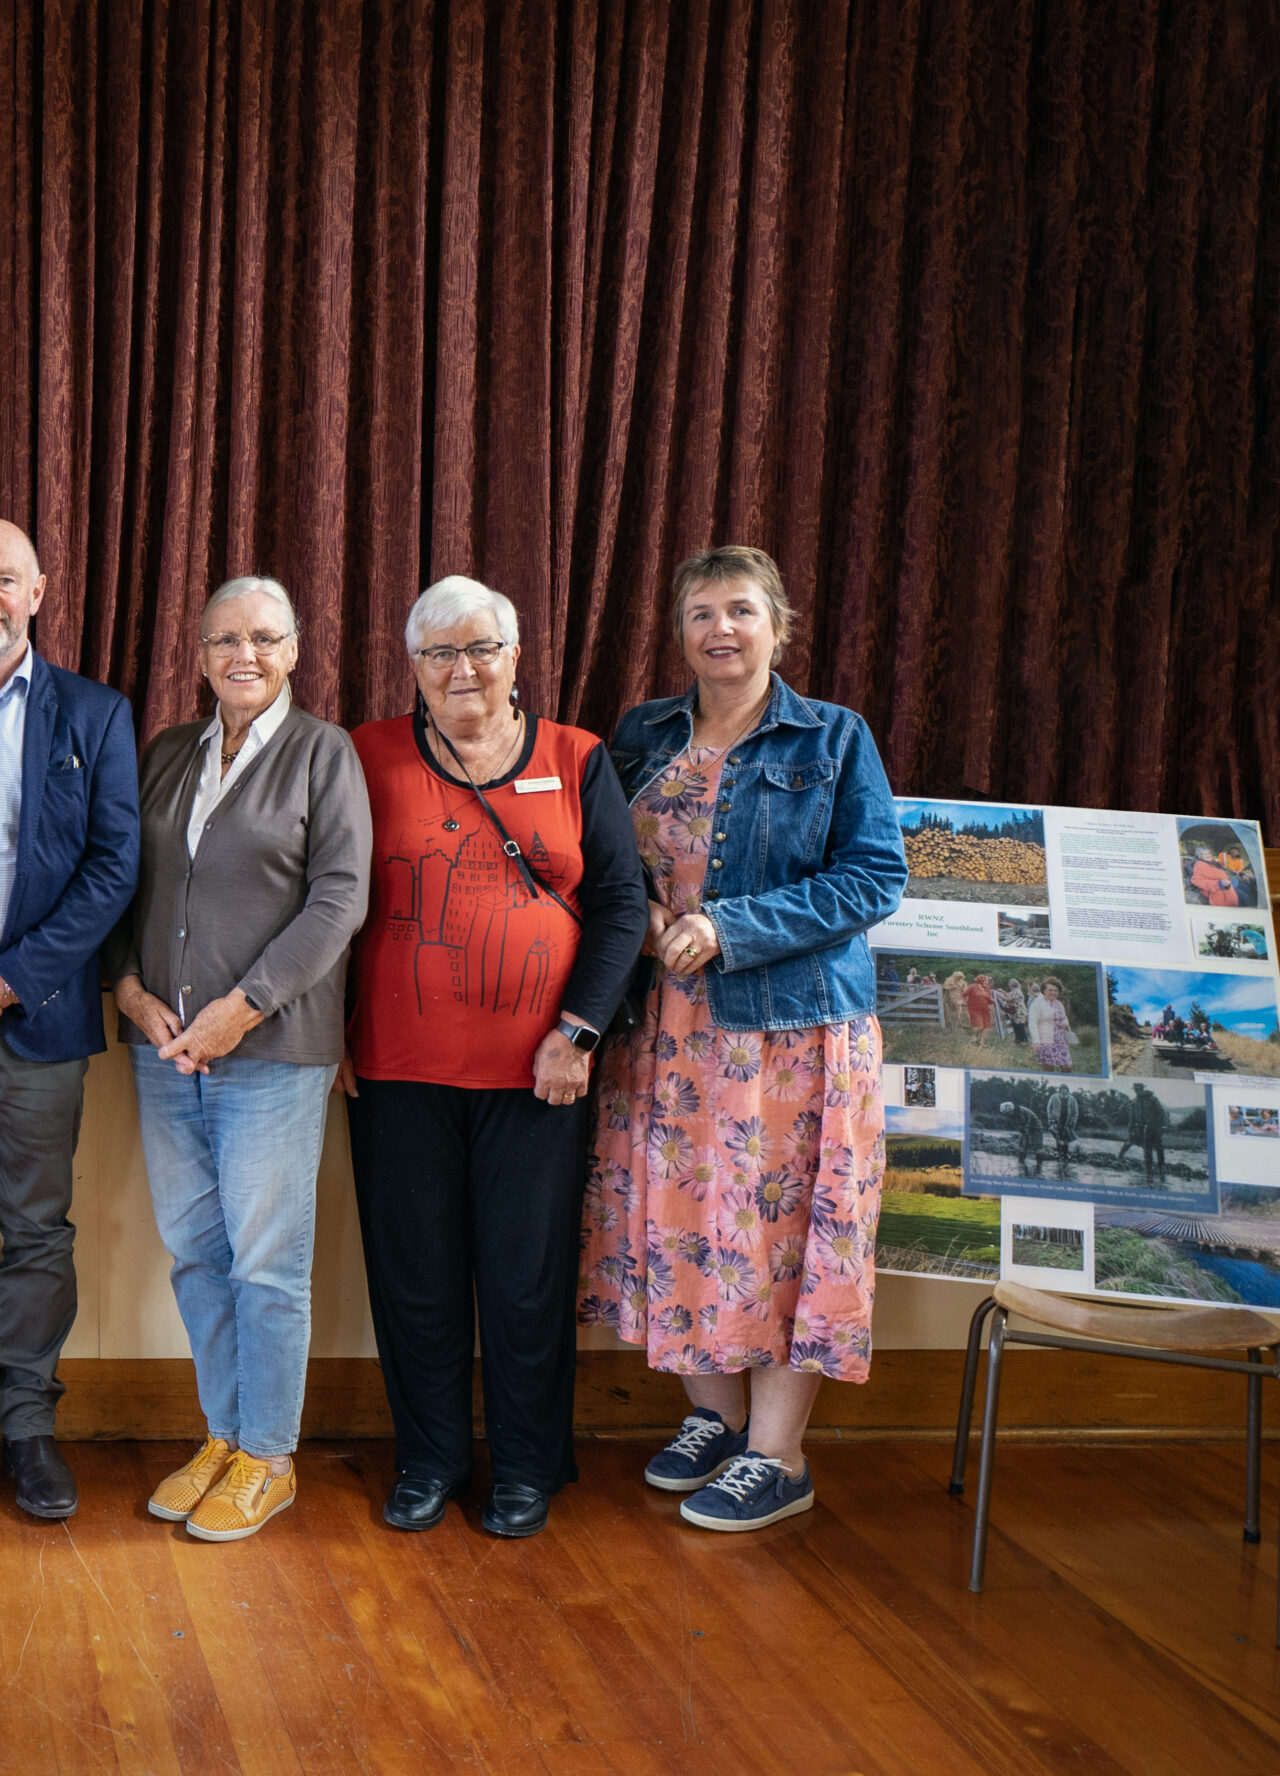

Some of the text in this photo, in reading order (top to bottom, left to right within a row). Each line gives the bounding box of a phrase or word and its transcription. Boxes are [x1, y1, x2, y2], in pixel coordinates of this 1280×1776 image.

[882, 919, 983, 932] Forestry Scheme Southland
